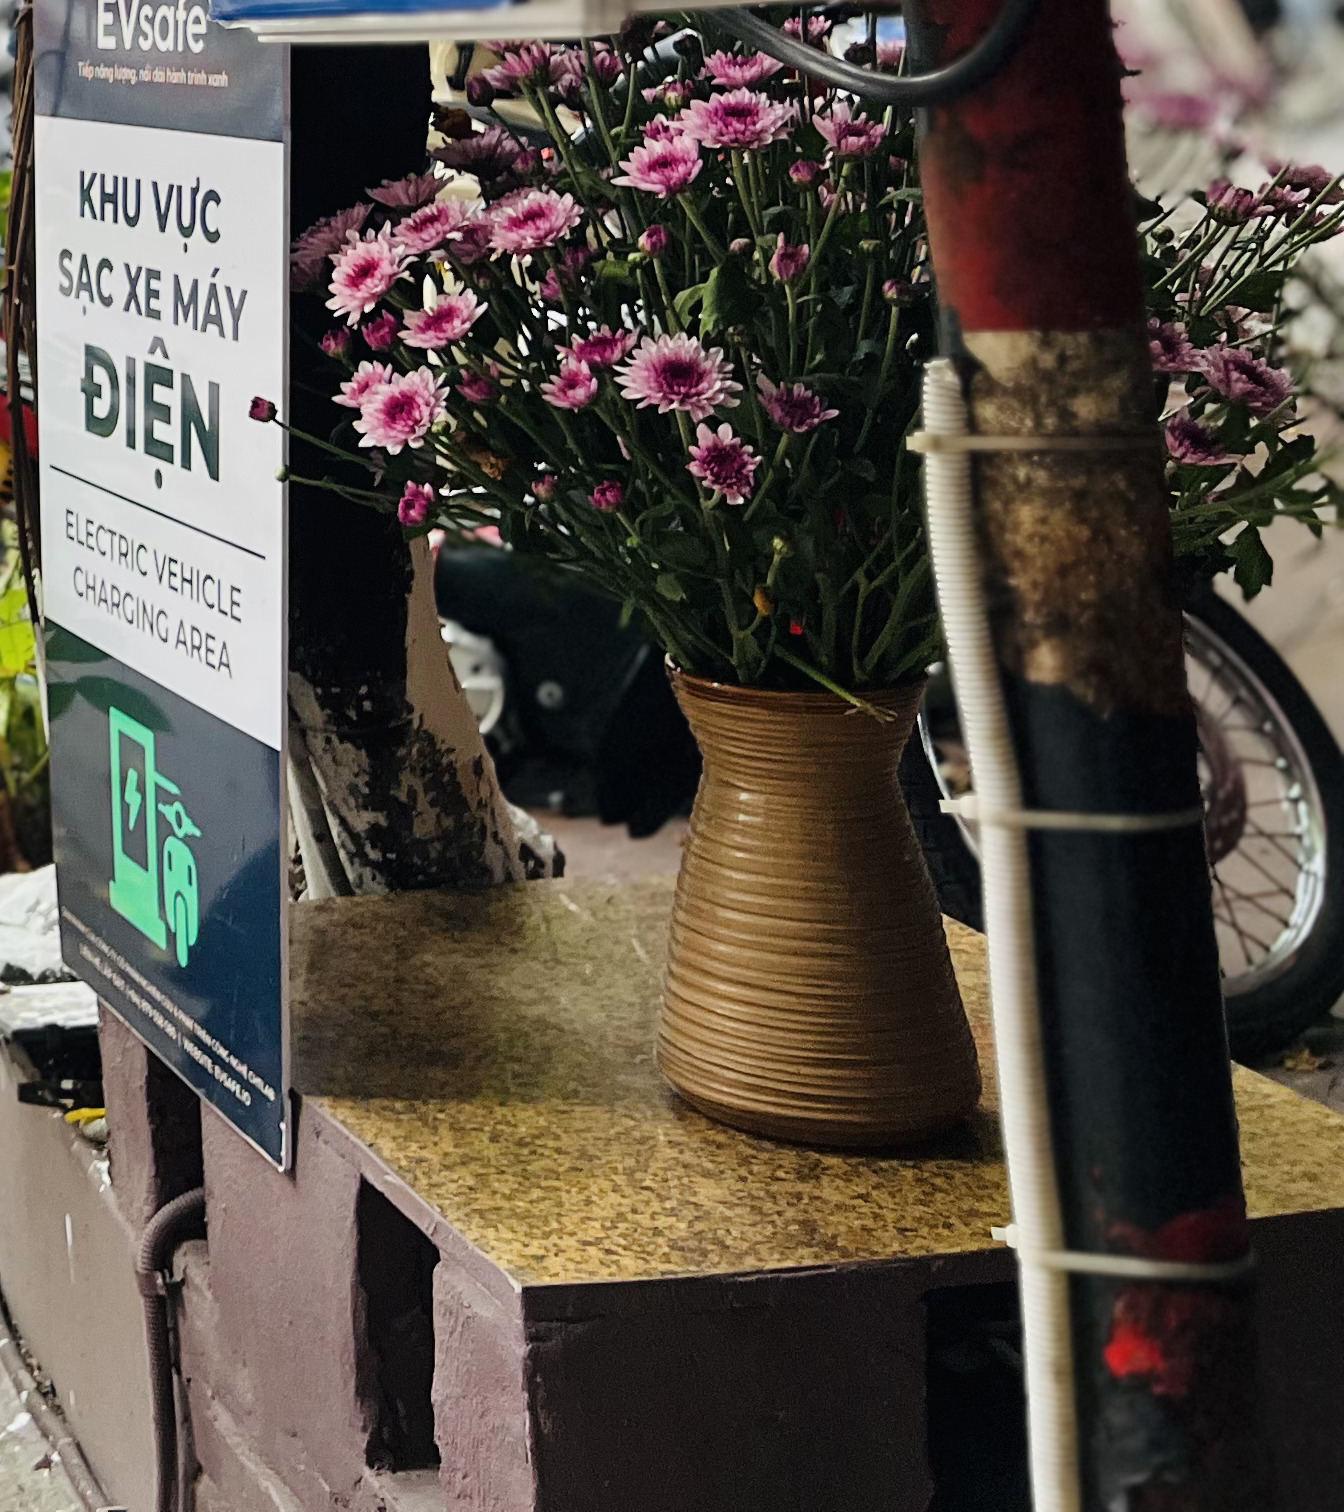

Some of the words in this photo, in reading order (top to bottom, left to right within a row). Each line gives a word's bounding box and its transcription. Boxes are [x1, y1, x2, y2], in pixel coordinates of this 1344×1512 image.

[79, 170, 141, 228] KHU
[151, 176, 222, 253] VỰC
[58, 248, 114, 316] SẠC
[122, 262, 161, 321] XE
[172, 267, 249, 343] MÁY
[80, 336, 221, 490] ĐIỆN
[65, 508, 148, 578] ELECTRIC
[153, 548, 242, 624] VEHICLE
[73, 565, 169, 644] CHARGING
[175, 618, 233, 680] AREA
